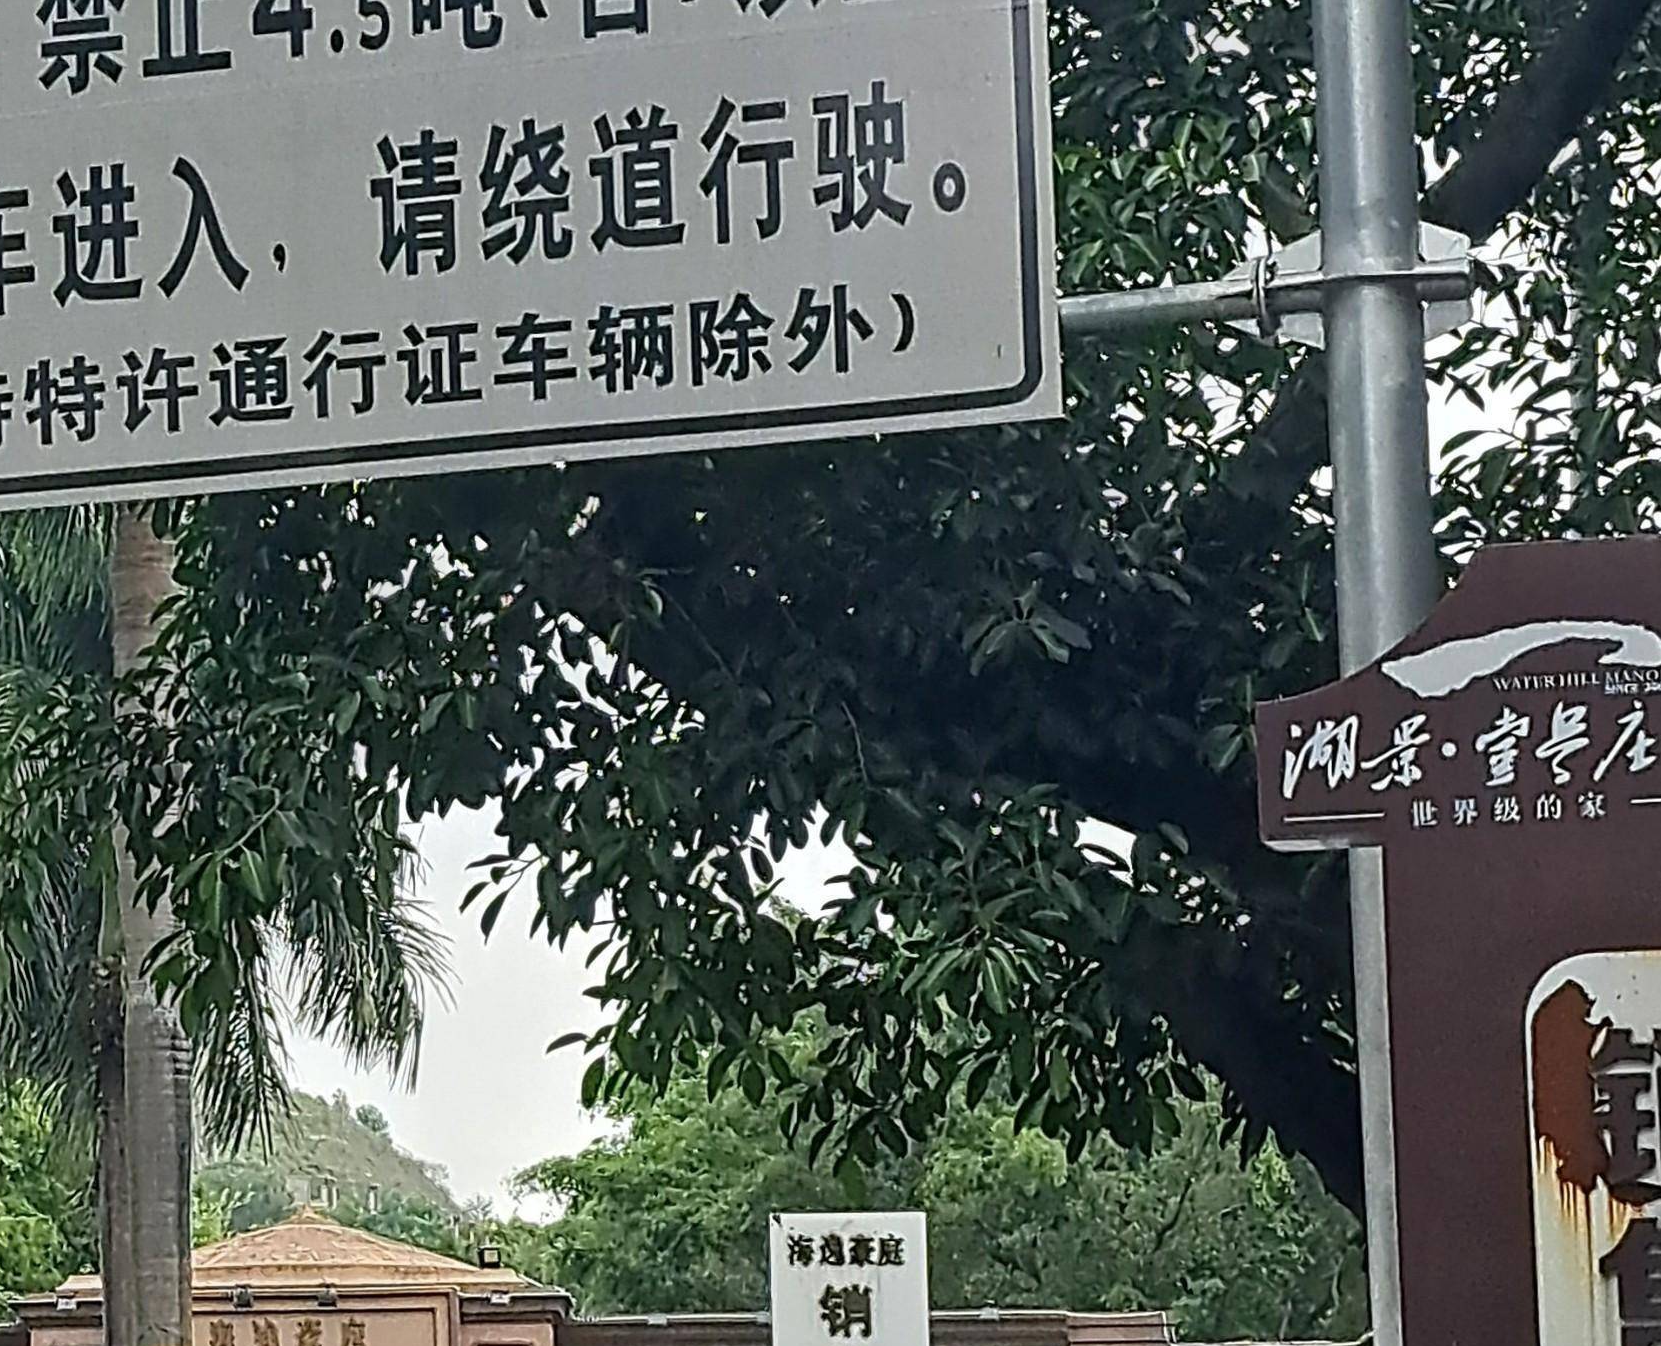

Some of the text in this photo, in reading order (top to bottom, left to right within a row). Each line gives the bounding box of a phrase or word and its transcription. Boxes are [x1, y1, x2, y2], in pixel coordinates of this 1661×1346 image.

[1410, 791, 1607, 828] 世界级的家
